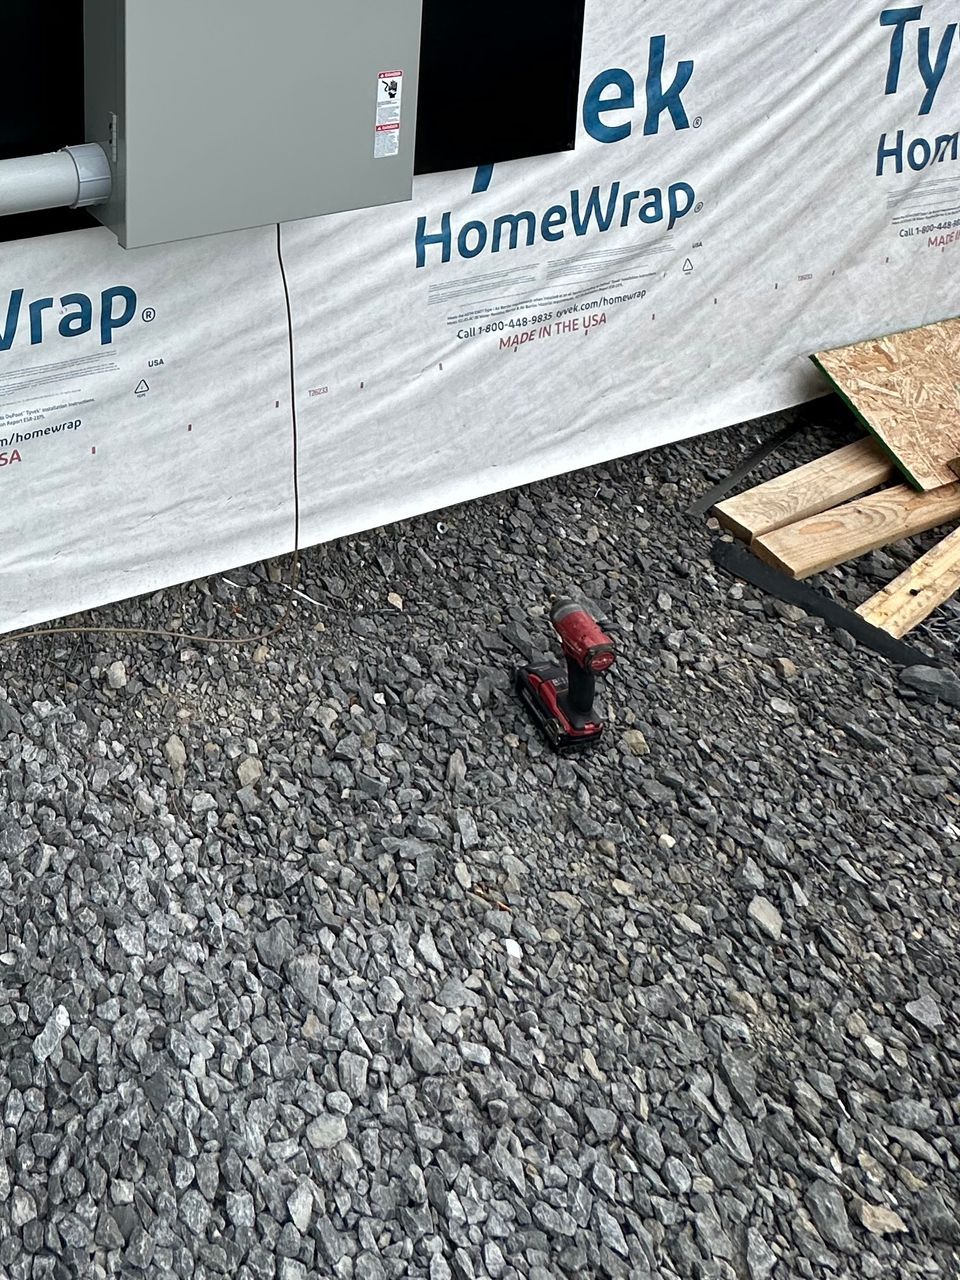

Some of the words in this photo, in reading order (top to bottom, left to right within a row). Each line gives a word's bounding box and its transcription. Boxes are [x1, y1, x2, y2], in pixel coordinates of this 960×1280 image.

[899, 227, 914, 238] Call
[457, 327, 476, 340] Call
[478, 312, 553, 335] 1-800-448-9835
[499, 329, 536, 351] MADE
[538, 325, 552, 339] IN
[554, 319, 579, 336] THE
[582, 312, 607, 329] USA
[148, 358, 165, 368] USA
